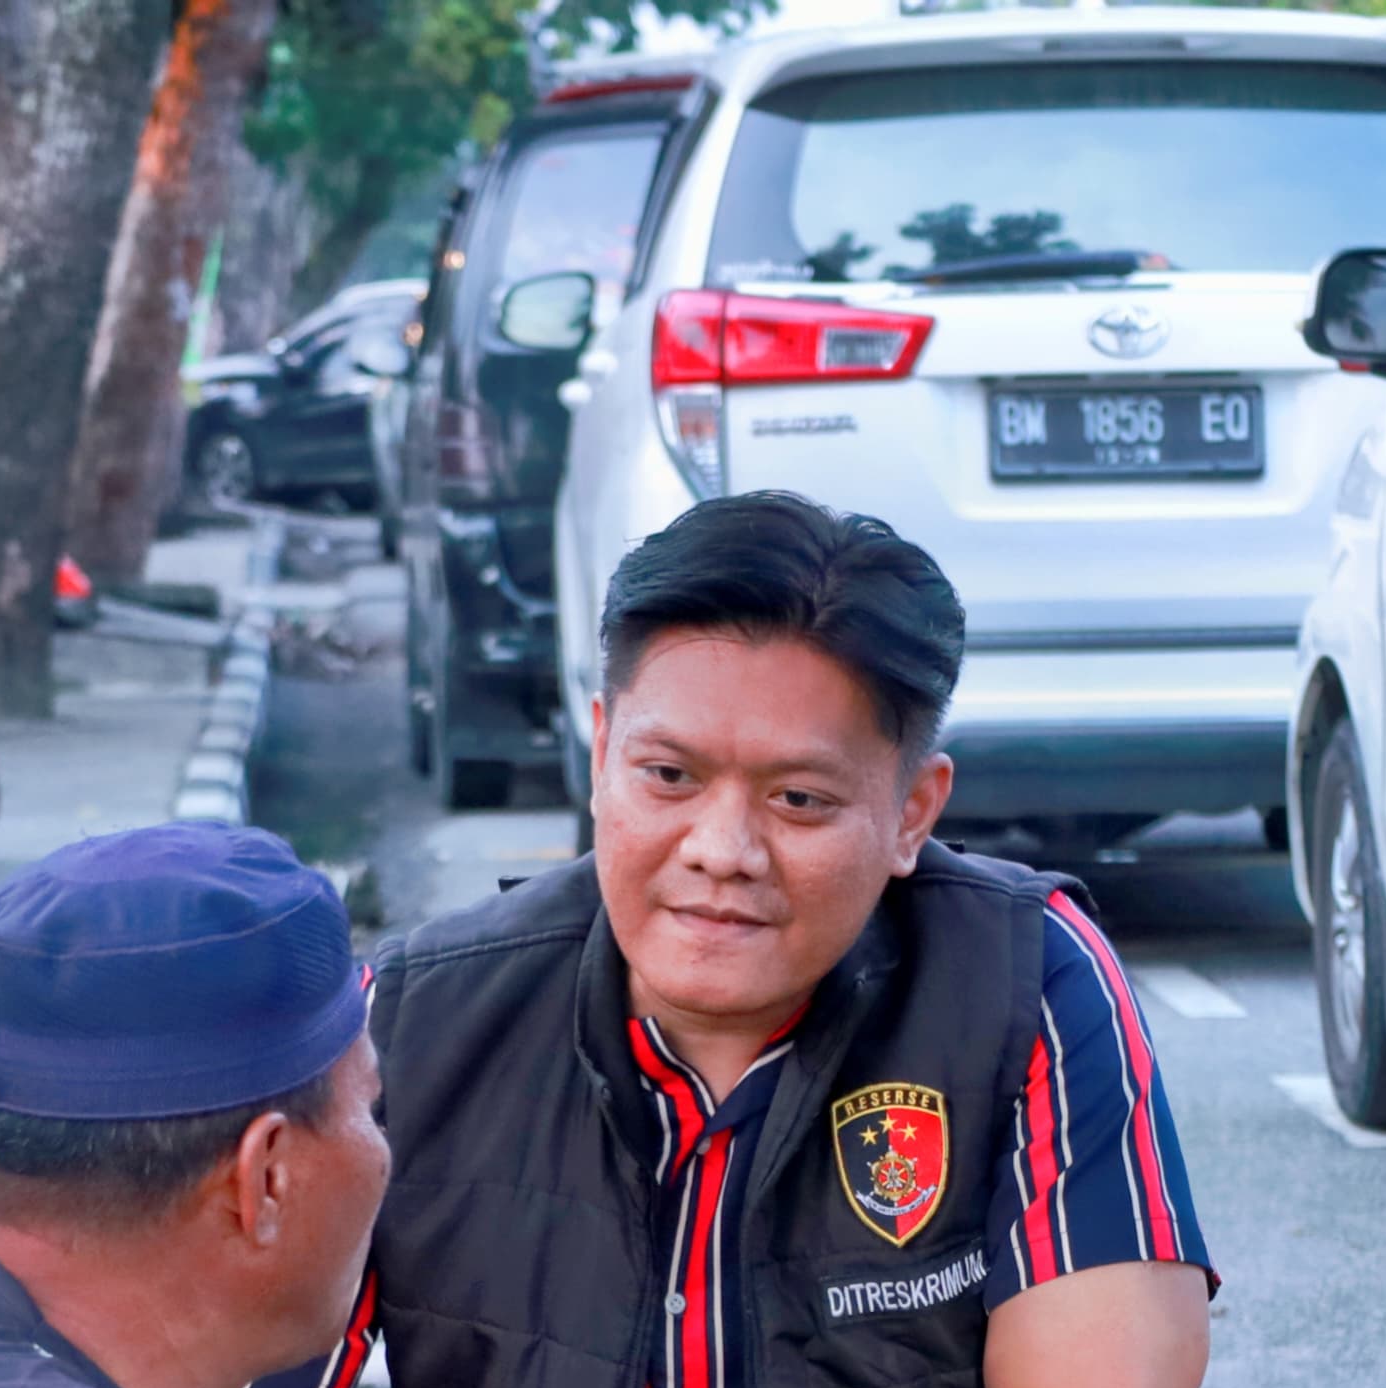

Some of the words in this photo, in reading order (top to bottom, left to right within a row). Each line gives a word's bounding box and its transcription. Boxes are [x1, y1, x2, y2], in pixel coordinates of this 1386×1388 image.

[1079, 397, 1165, 444] 1856
[844, 1089, 931, 1117] RESERSE
[826, 1249, 988, 1318] DITRESKRIMUM
